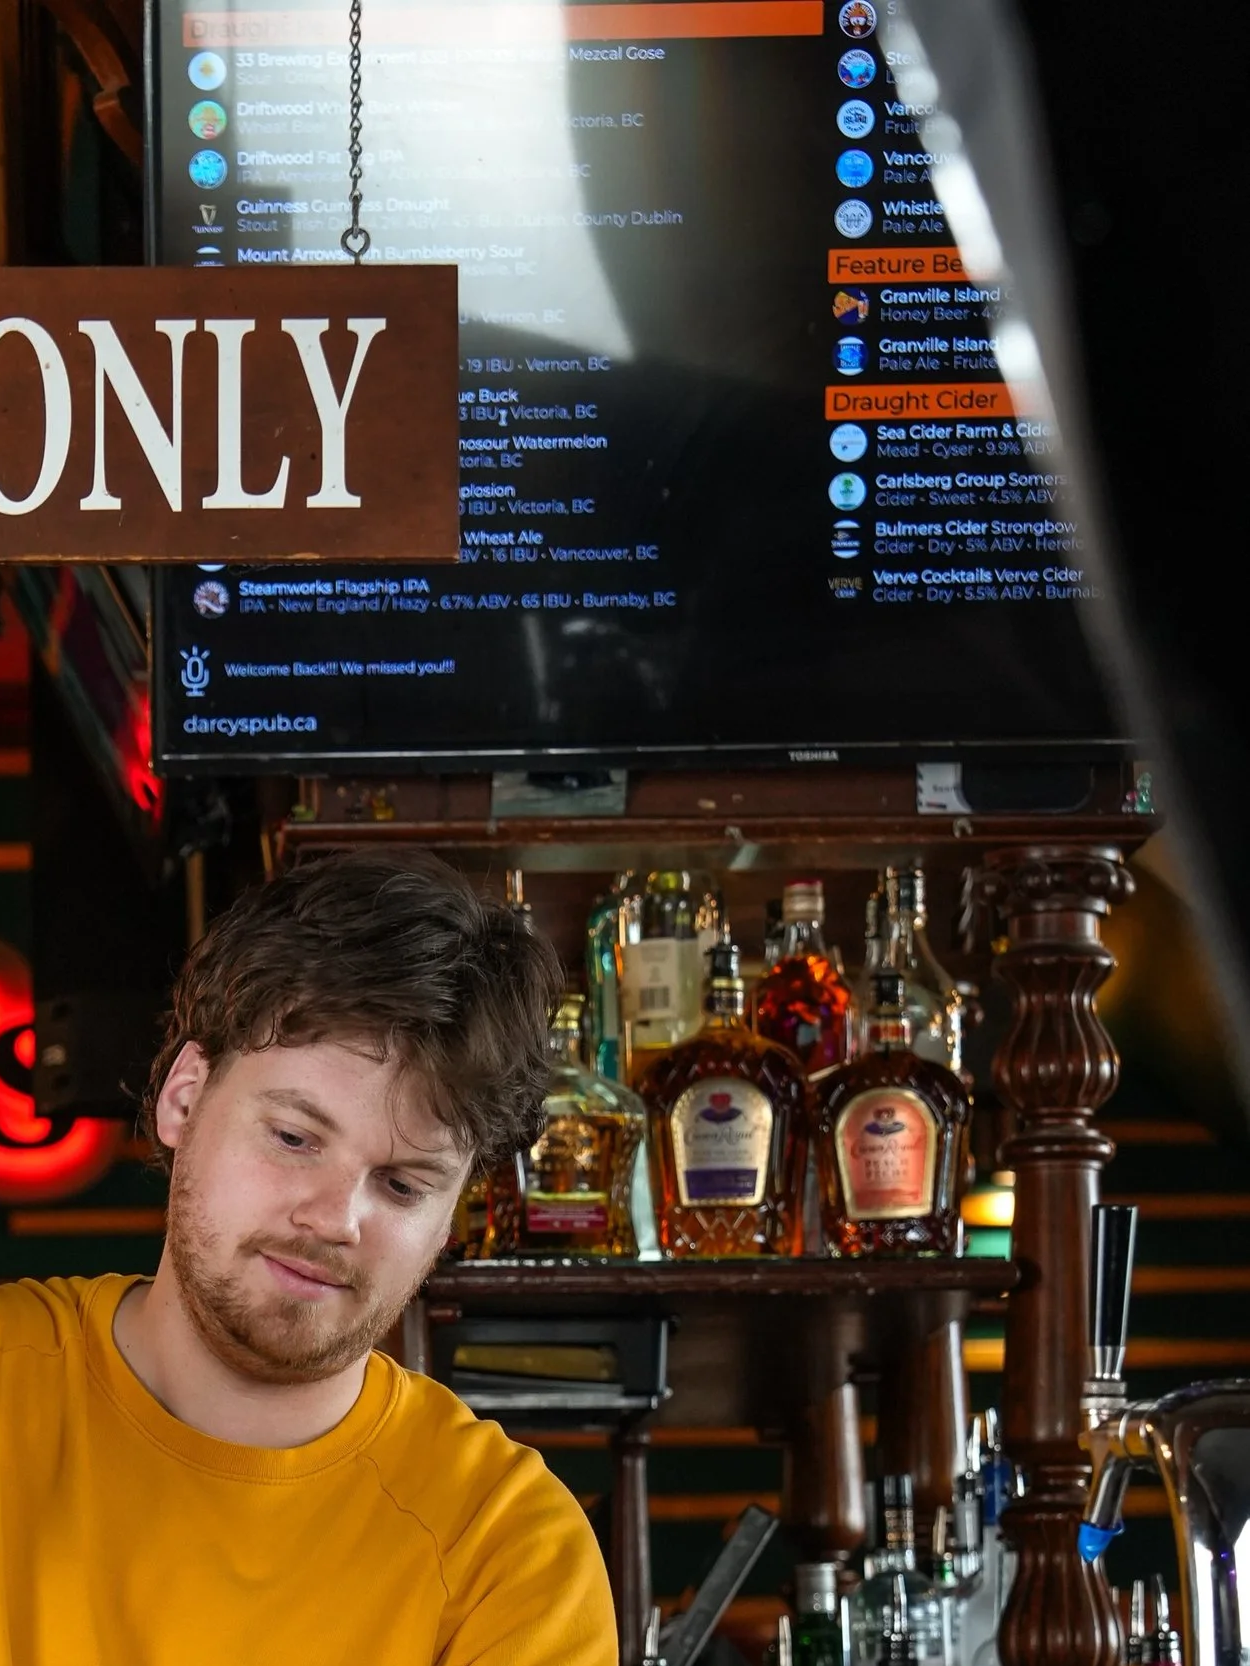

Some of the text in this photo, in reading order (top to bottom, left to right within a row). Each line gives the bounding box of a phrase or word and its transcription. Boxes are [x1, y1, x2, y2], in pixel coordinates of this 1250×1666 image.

[569, 46, 622, 61] Mezcal
[625, 45, 666, 61] Gose
[236, 100, 314, 117] Driftwood
[622, 113, 645, 128] BC
[883, 119, 920, 134] Fruit
[236, 150, 314, 166] Driftwood
[883, 169, 918, 184] Pale
[235, 199, 309, 215] Guinness
[236, 218, 279, 232] Stout
[572, 211, 628, 229] County
[630, 209, 684, 226] Dublin
[882, 218, 944, 234] Pale Ale
[236, 248, 290, 263] Mount
[835, 254, 925, 276] Feature
[880, 286, 1001, 305] Granville Island
[880, 307, 930, 324] Honey
[934, 306, 970, 321] Beer
[879, 337, 950, 355] Granville
[466, 356, 611, 373] 19 IBU Vernon, BC
[879, 356, 913, 372] Pale
[915, 355, 940, 371] Ale
[458, 387, 519, 404] ue Buck
[832, 389, 999, 416] Draught Cider
[470, 406, 498, 421] IBU
[509, 404, 572, 421] Victoria,
[575, 403, 598, 419] BC
[876, 424, 906, 440] Sea
[910, 423, 953, 440] Cider
[955, 422, 998, 439] Farm
[1001, 422, 1014, 438] &
[458, 433, 609, 451] nosour Watermelon
[876, 442, 920, 458] Mead
[932, 442, 975, 461] Cyser
[459, 453, 524, 469] toria, BC
[875, 471, 1068, 491] Carlsberg Group Somers
[458, 482, 516, 500] plosion
[875, 488, 1056, 506] Cider Sweet 4.5% ABV
[468, 498, 596, 516] IBU Victoria, BC
[875, 518, 1078, 537] Bulmers Cider Strongbow
[464, 529, 544, 546] Wheat Ale
[874, 538, 914, 554] Cider
[928, 537, 954, 555] Dry
[965, 537, 988, 552] 5%
[990, 536, 1024, 552] ABV
[459, 548, 481, 563] BV
[510, 547, 538, 562] IBU
[549, 547, 634, 562] Vancouver,
[636, 545, 659, 561] BC
[873, 567, 1084, 586] Verve Cocktails Verve Cider
[239, 578, 431, 598] Steamworks Flagship IPA
[873, 586, 914, 603] Cider
[927, 586, 953, 604] Dry
[965, 585, 998, 601] 5.5%
[1000, 584, 1035, 600] ABV
[1045, 583, 1101, 599] Burnab
[239, 599, 267, 614] IPA
[278, 598, 314, 613] New
[316, 597, 380, 616] England
[391, 597, 430, 614] Hazy
[440, 595, 476, 611] 6.7%
[477, 593, 512, 609] ABV
[521, 593, 541, 609] 65
[543, 593, 572, 609] IBU
[582, 591, 650, 610] Burnaby,
[653, 591, 677, 607] BC
[224, 662, 291, 678] Welcome
[293, 661, 339, 677] Back!!!
[340, 661, 365, 676] We
[366, 660, 416, 676] missed
[183, 714, 318, 737] darcyspub.ca
[788, 750, 839, 762] TOSHIBA
